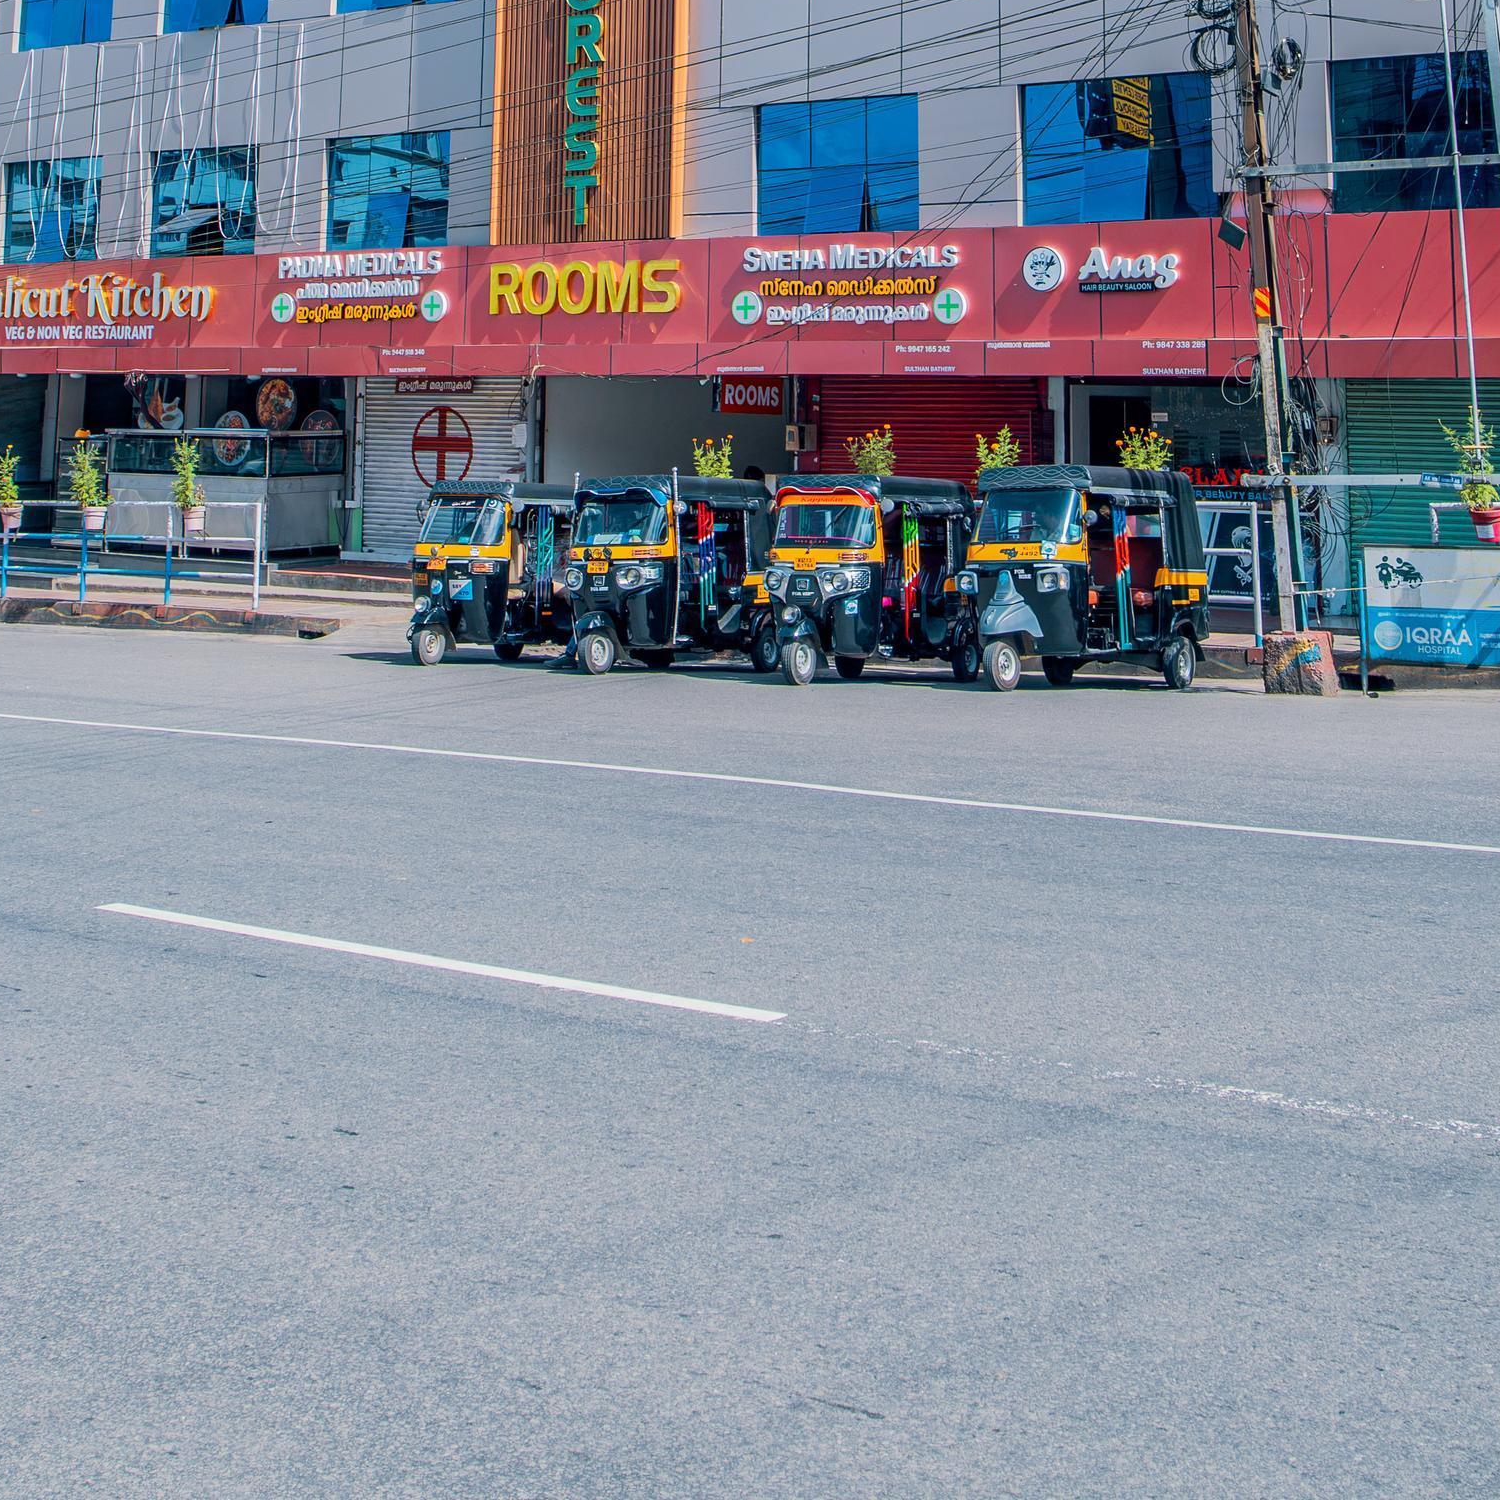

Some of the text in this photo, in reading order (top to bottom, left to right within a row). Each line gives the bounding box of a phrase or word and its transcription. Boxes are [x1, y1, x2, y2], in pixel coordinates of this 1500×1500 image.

[278, 251, 442, 279] PADMA MEDICALS
[743, 243, 960, 272] SNEHA MEDICALS
[1078, 247, 1180, 289] Anas
[489, 259, 682, 315] ROOMS
[759, 275, 938, 297] സ്നേഹ മെഡിക്കൽസ്
[1098, 283, 1124, 291] BEAUTY
[1124, 282, 1152, 291] SALOON
[80, 271, 216, 326] Kitchen
[345, 302, 416, 321] മരുന്നുകൾ
[832, 302, 930, 323] മരുന്നുകൾ
[5, 325, 154, 339] VEG & NON VEG RESTAURANT
[895, 345, 906, 353] Ph:
[938, 345, 950, 353] 242
[1142, 341, 1155, 349] Ph:
[1156, 341, 1175, 349] 9847
[1176, 341, 1191, 349] 338
[725, 384, 779, 406] ROOMS
[1205, 490, 1246, 500] BEAUTY
[1418, 645, 1462, 655] HOSPITAL
